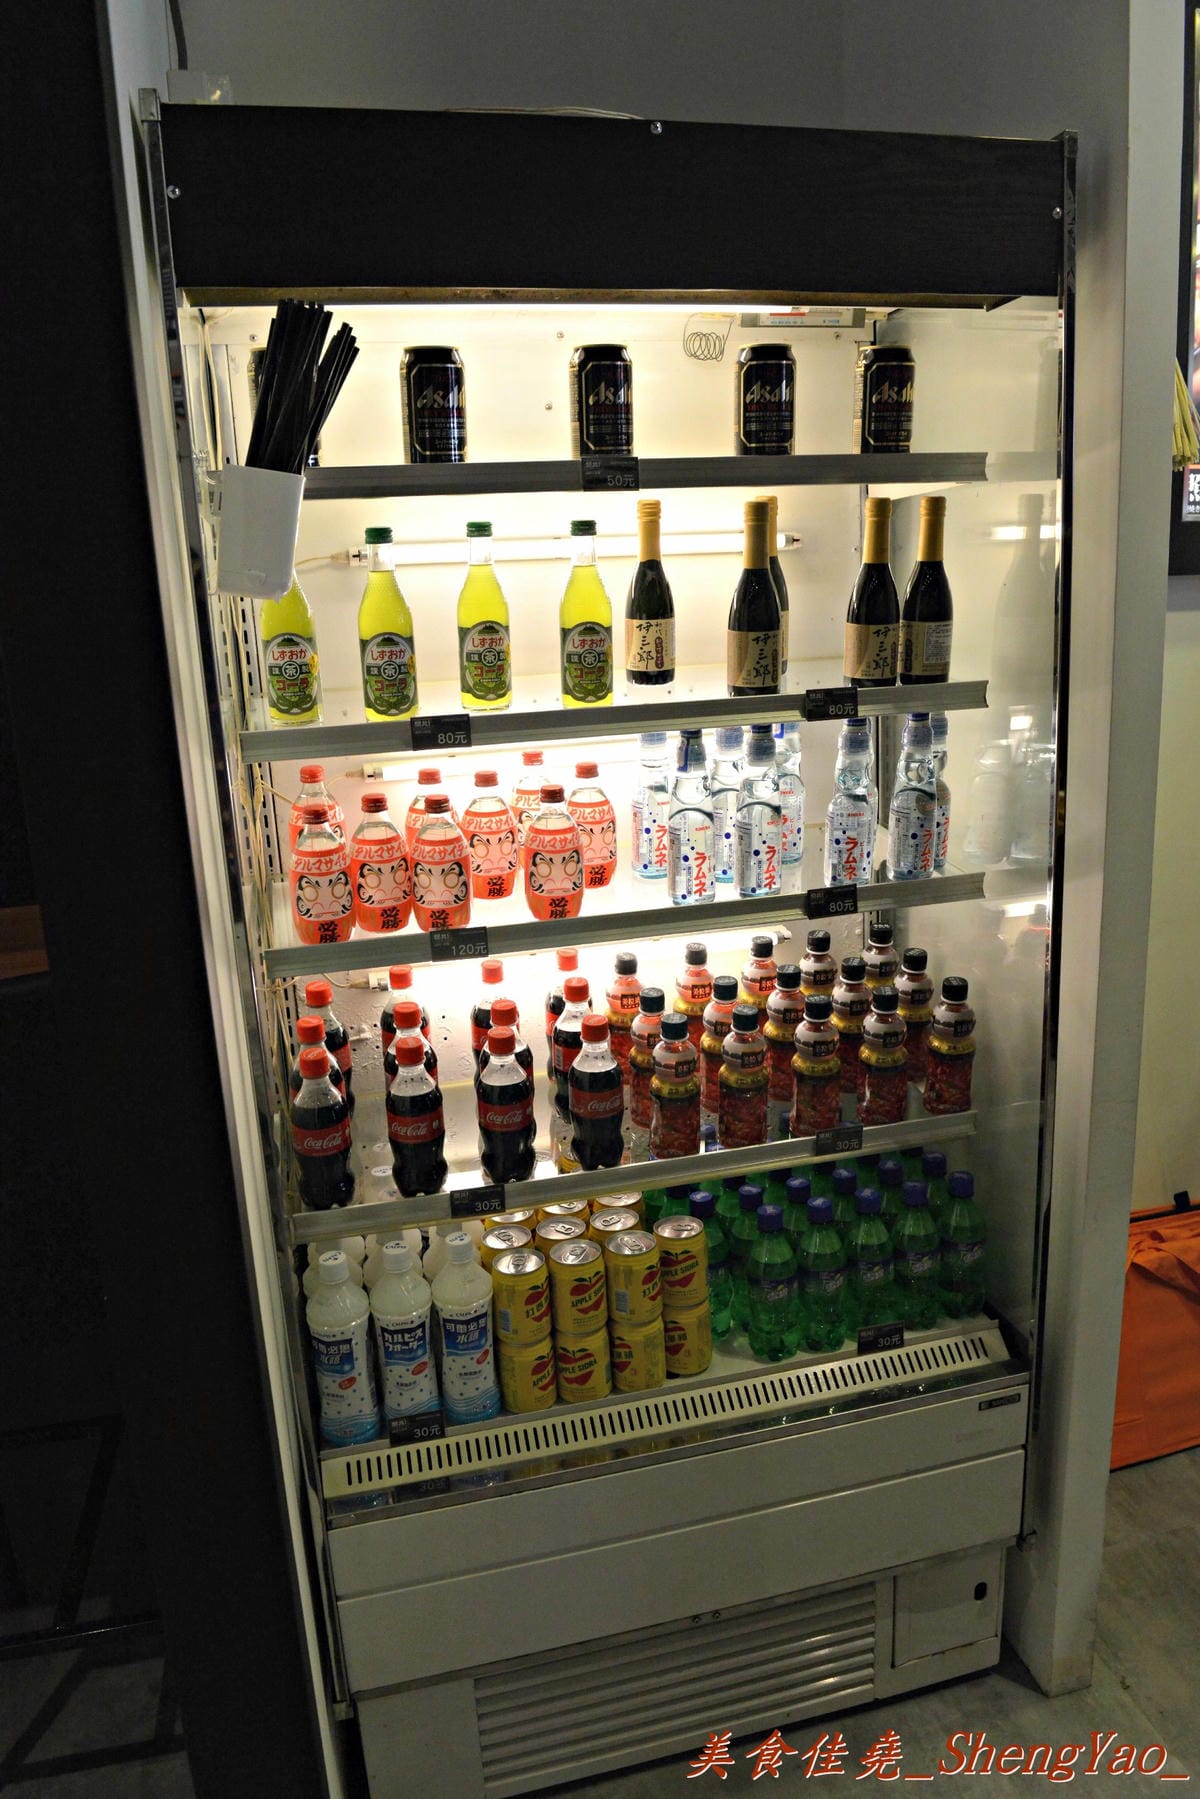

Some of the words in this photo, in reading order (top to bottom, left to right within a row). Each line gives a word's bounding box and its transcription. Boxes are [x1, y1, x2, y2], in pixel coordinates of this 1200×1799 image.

[607, 475, 635, 487] 50元
[829, 703, 855, 716] 80元
[438, 730, 468, 745] 80元
[655, 824, 668, 868] ラムネ
[919, 828, 933, 873] ラムネ
[844, 837, 858, 881] ラムネ
[694, 852, 708, 897] ラムネ
[764, 845, 777, 890] ラムネ
[829, 899, 855, 913] 80元
[452, 942, 488, 957] 120元
[836, 1140, 860, 1150] 30元
[475, 1200, 502, 1212] 30元
[383, 1327, 425, 1344] カルピス
[413, 1424, 441, 1439] 30元
